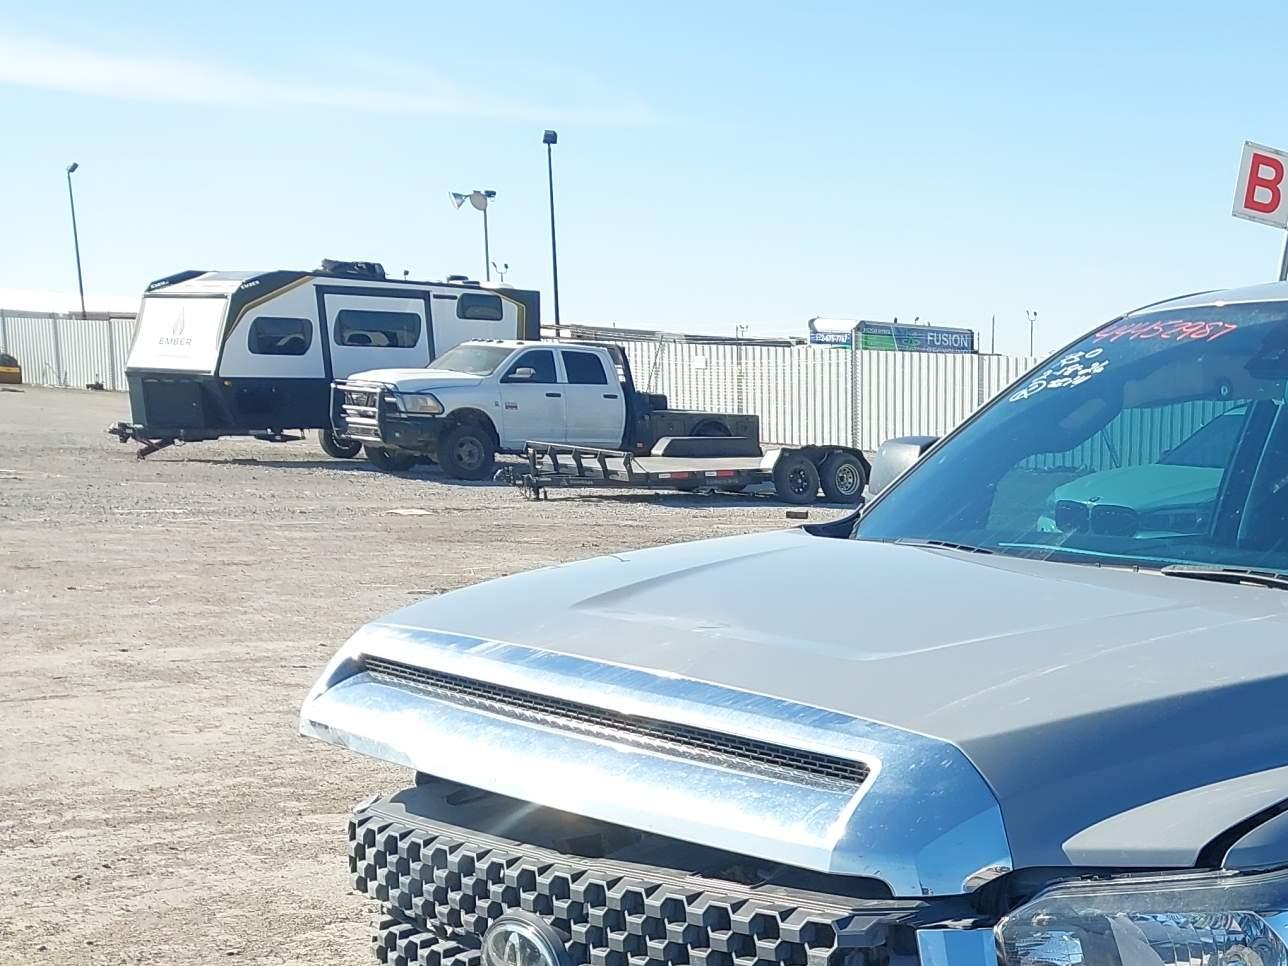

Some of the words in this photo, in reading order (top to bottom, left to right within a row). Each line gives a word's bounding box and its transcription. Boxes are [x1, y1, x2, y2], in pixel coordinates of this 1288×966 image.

[1243, 152, 1284, 214] B
[158, 336, 192, 346] EMBER
[927, 332, 969, 348] FUSION
